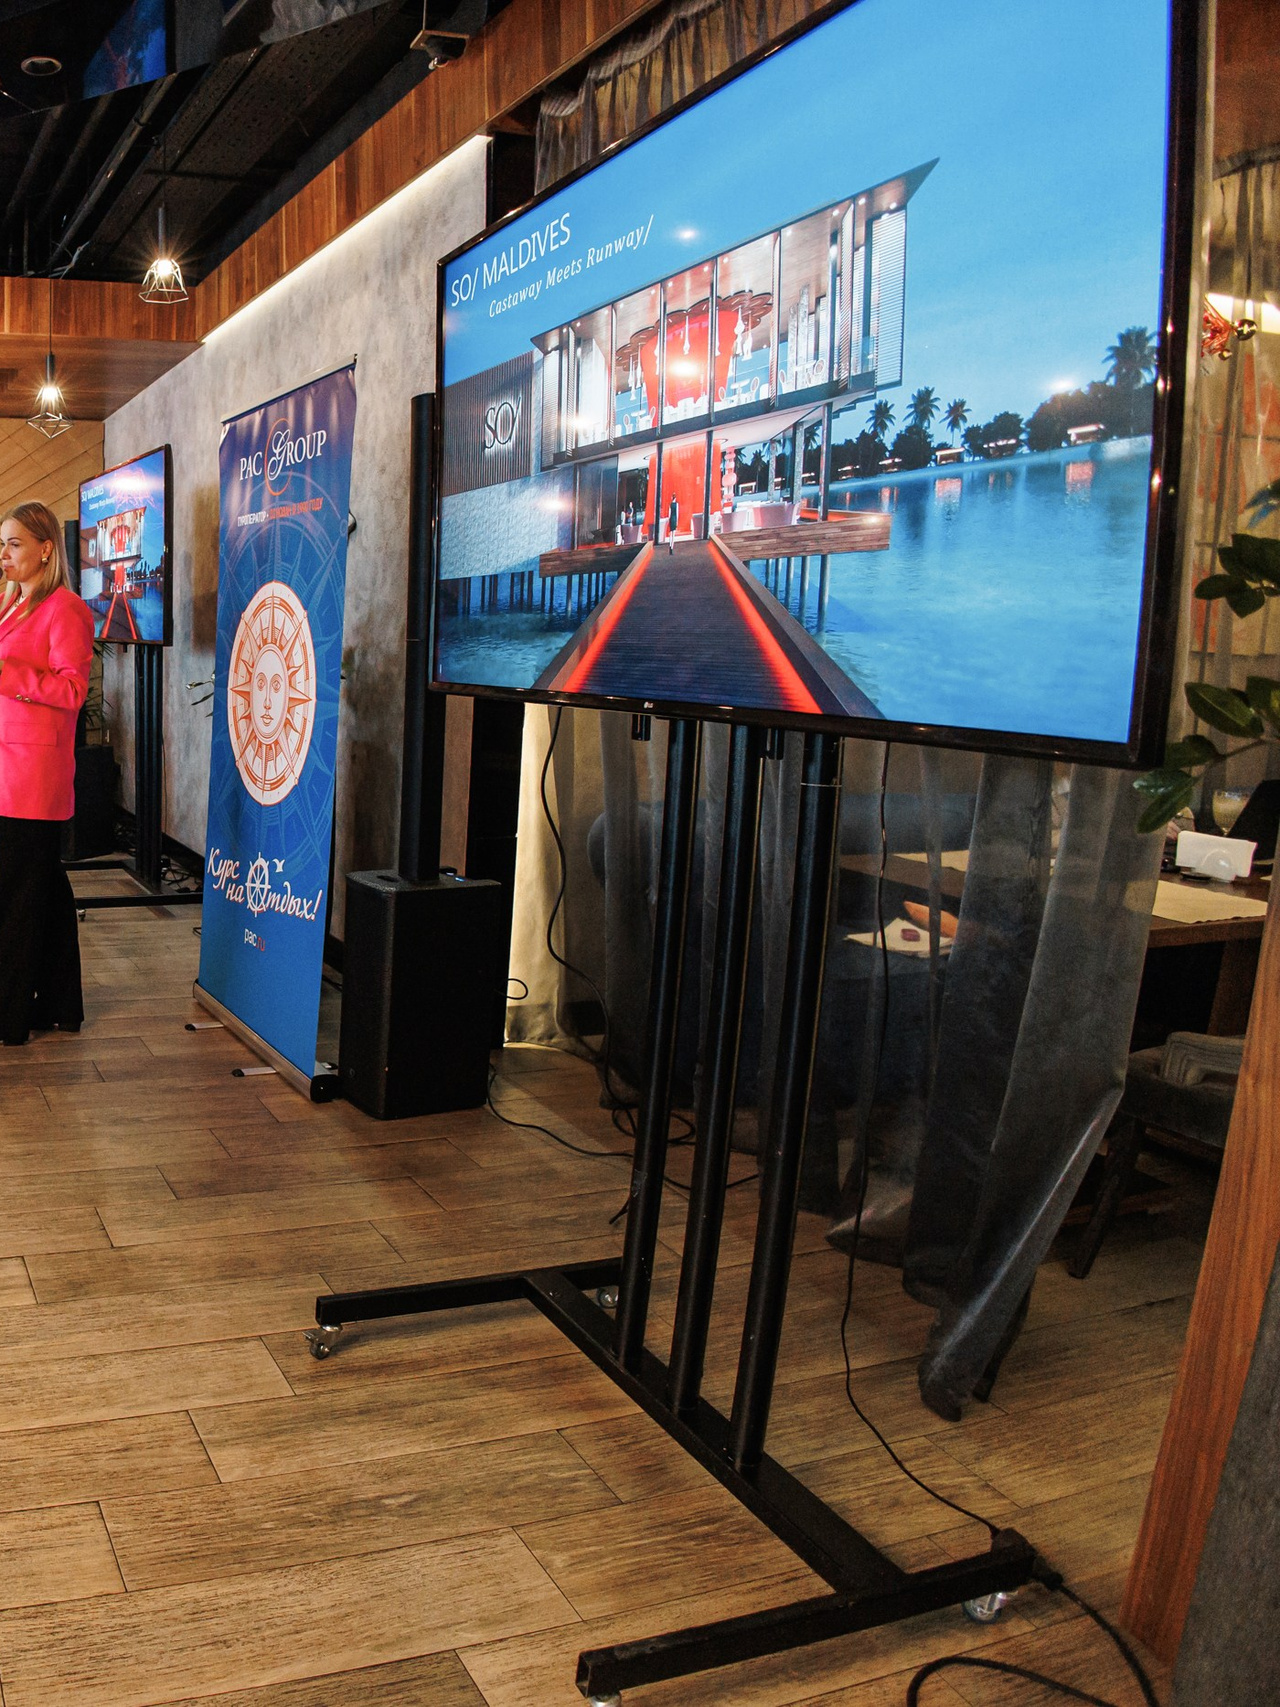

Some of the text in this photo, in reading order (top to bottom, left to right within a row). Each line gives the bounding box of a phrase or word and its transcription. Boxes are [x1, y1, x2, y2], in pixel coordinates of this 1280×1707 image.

[451, 212, 571, 307] SO/ MALDIVES
[488, 214, 655, 318] Castaway Meets Runway/
[239, 429, 327, 481] PAC GROUP
[207, 847, 240, 889] Курс
[226, 882, 245, 903] на
[244, 928, 266, 952] pac.ru
